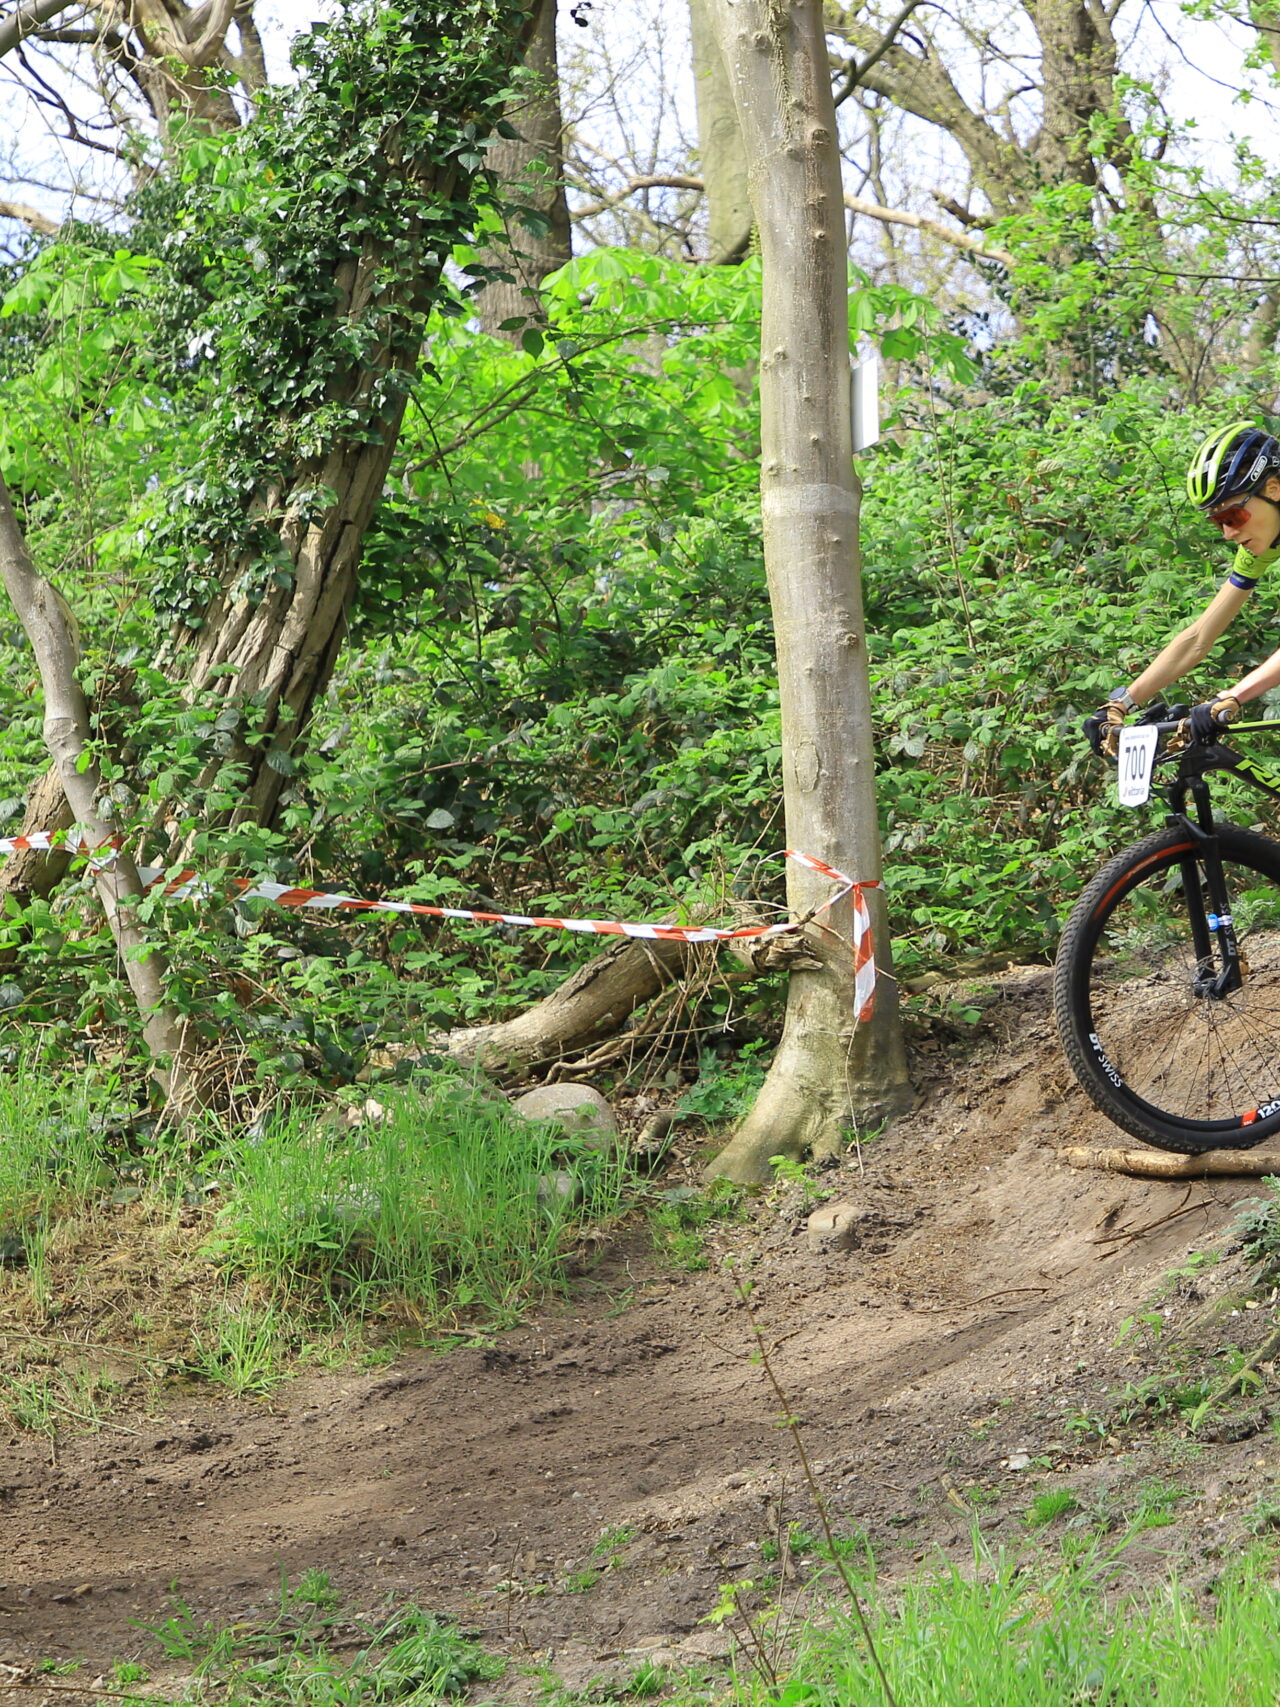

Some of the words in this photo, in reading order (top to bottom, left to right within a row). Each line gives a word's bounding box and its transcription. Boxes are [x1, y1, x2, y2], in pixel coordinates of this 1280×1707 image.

[1125, 744, 1146, 780] 700
[1089, 1033, 1103, 1051] DT
[1098, 1055, 1124, 1088] SWISS
